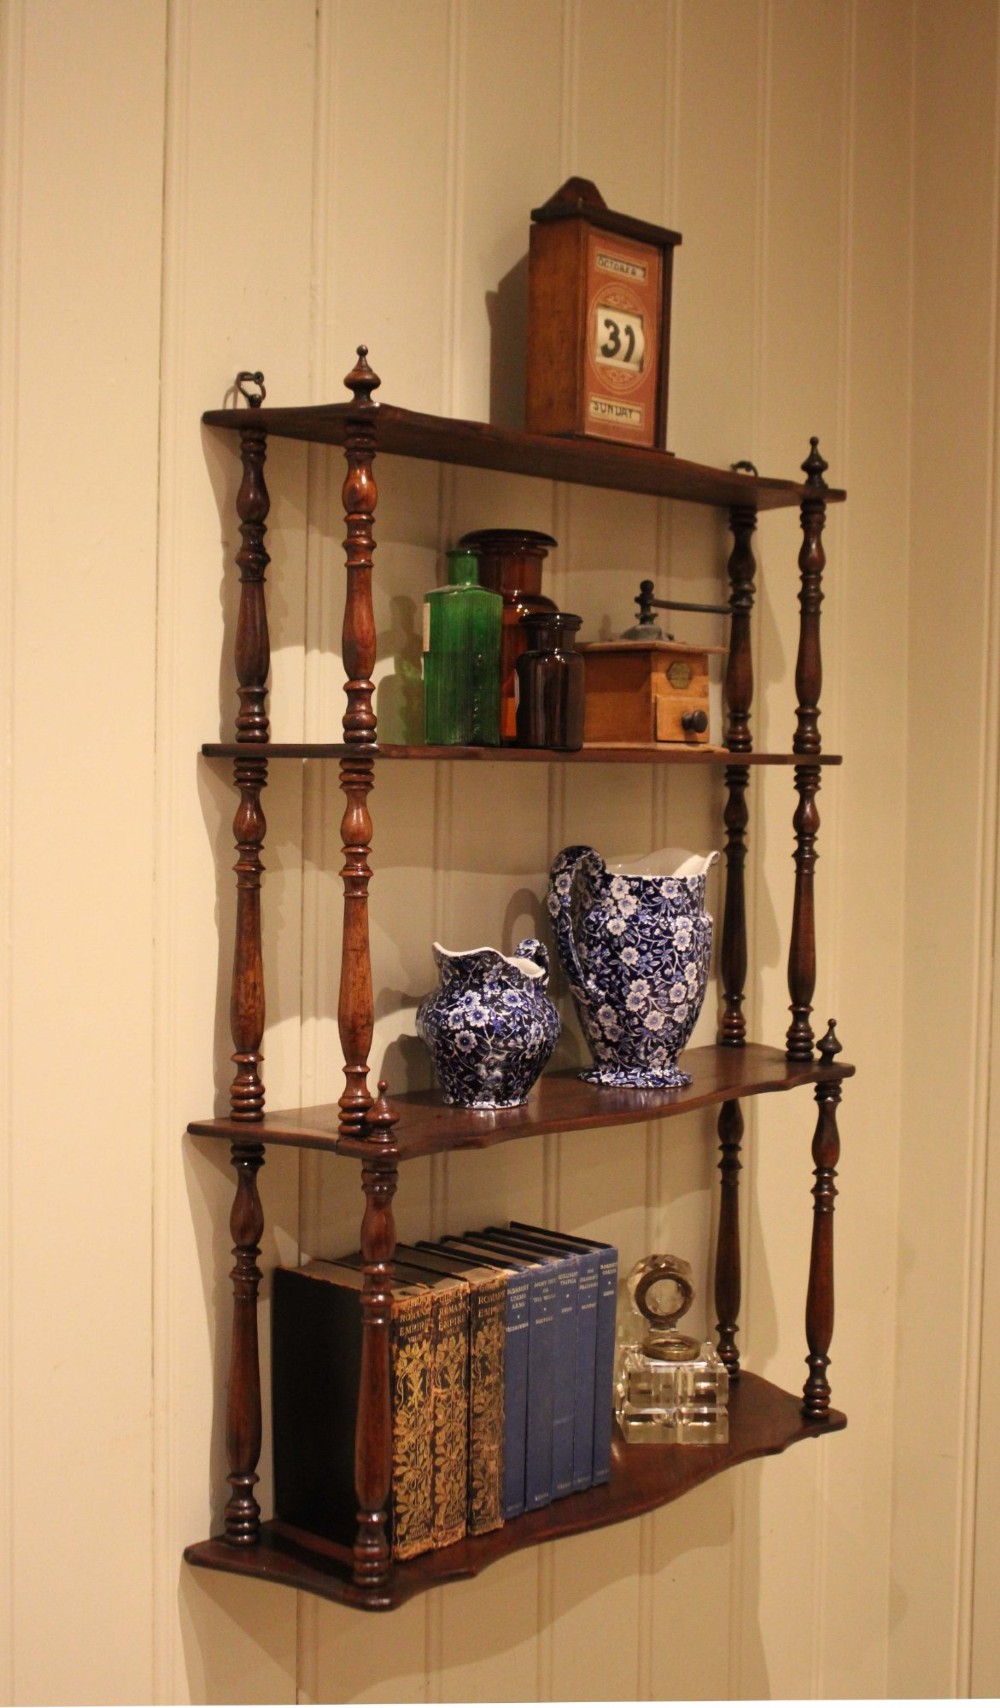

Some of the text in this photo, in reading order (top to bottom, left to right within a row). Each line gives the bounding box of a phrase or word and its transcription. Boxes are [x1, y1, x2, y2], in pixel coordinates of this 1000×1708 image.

[598, 256, 637, 276] OCTOBER
[600, 318, 636, 363] 31
[592, 400, 635, 419] SUNDAY
